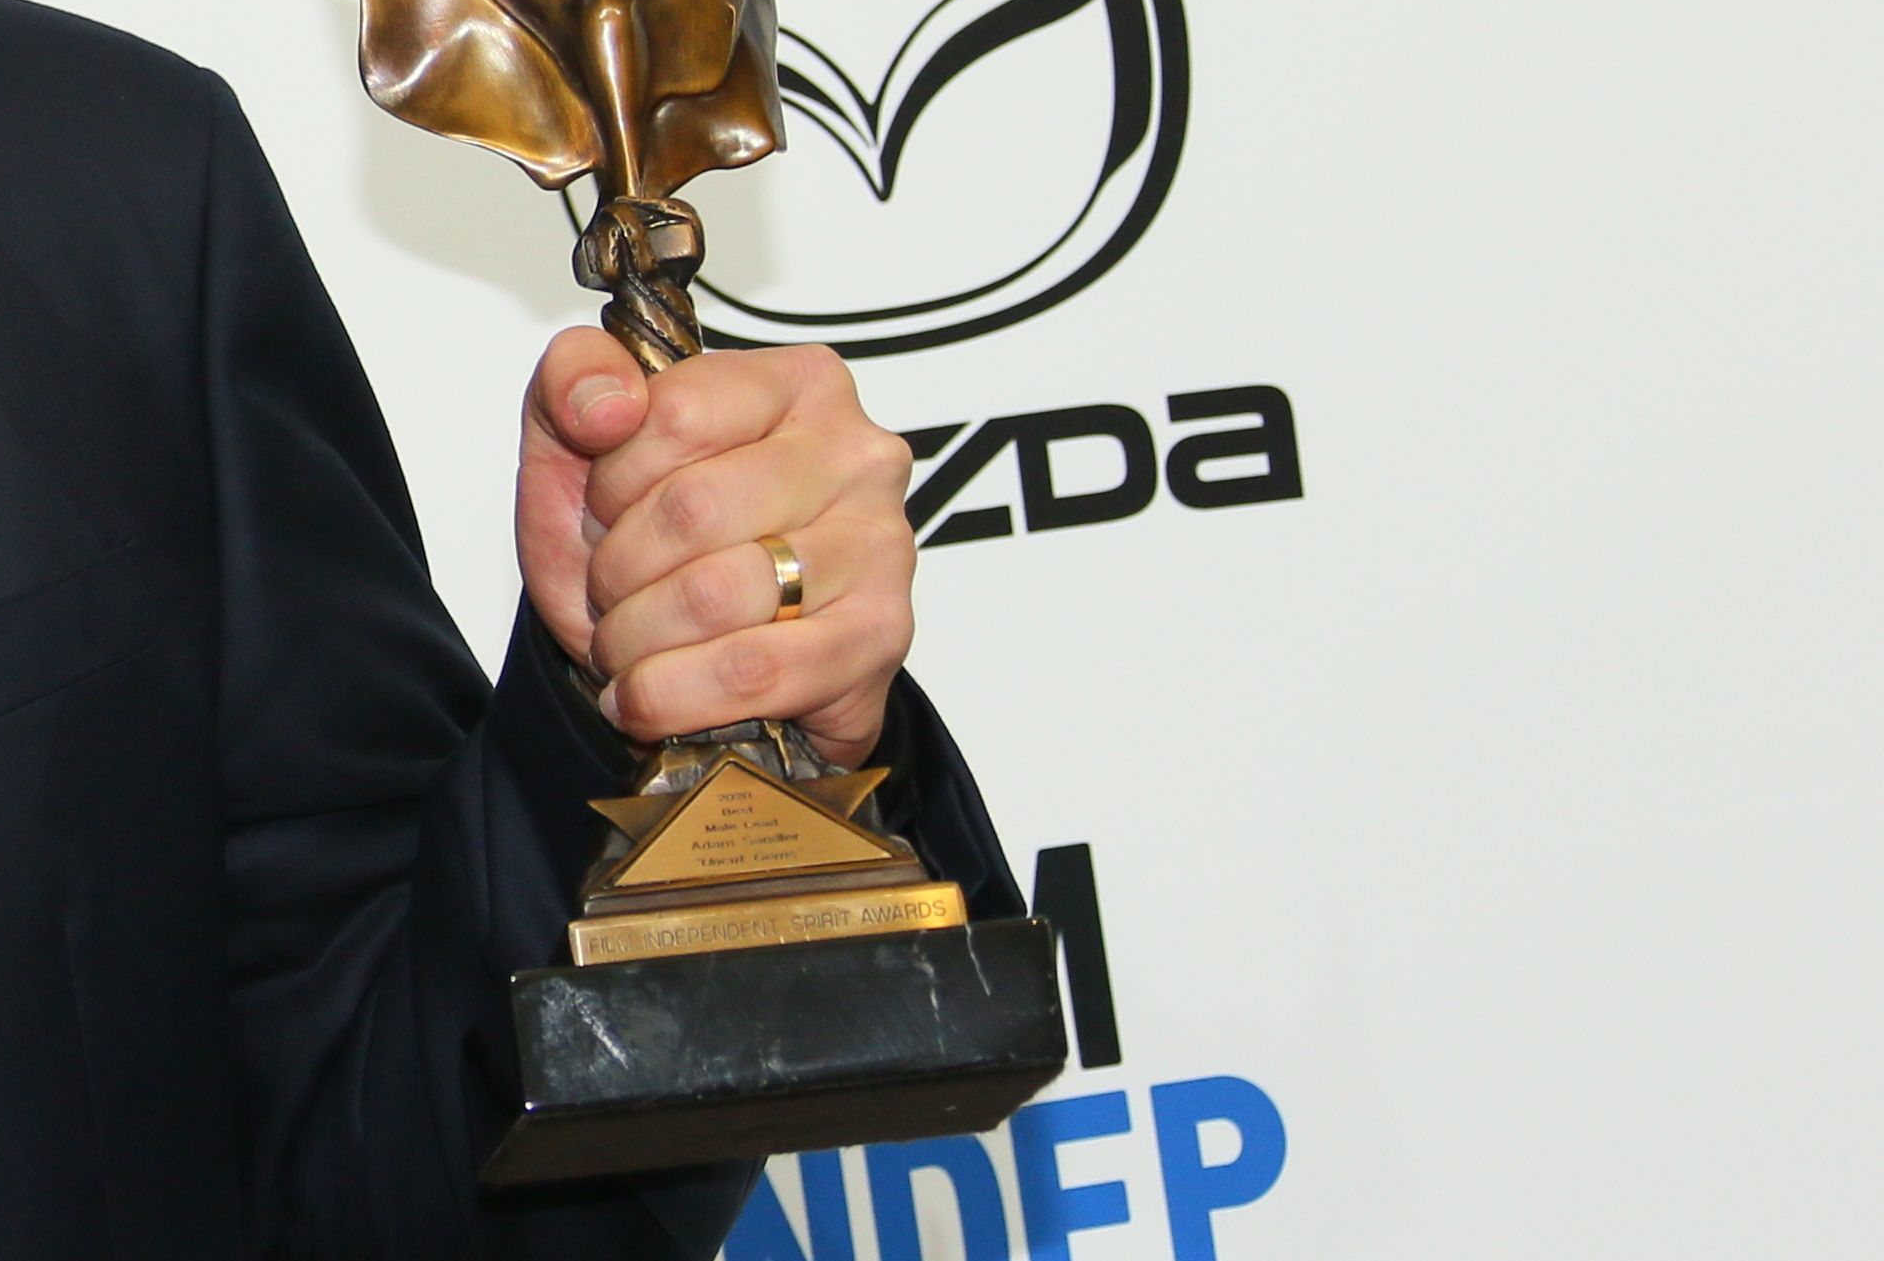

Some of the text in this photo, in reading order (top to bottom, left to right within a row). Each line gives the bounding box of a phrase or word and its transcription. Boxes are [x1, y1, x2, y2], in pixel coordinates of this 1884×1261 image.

[642, 917, 781, 952] INDEPENDENT
[789, 907, 853, 933] SPIRIT
[860, 899, 947, 926] AWARDS
